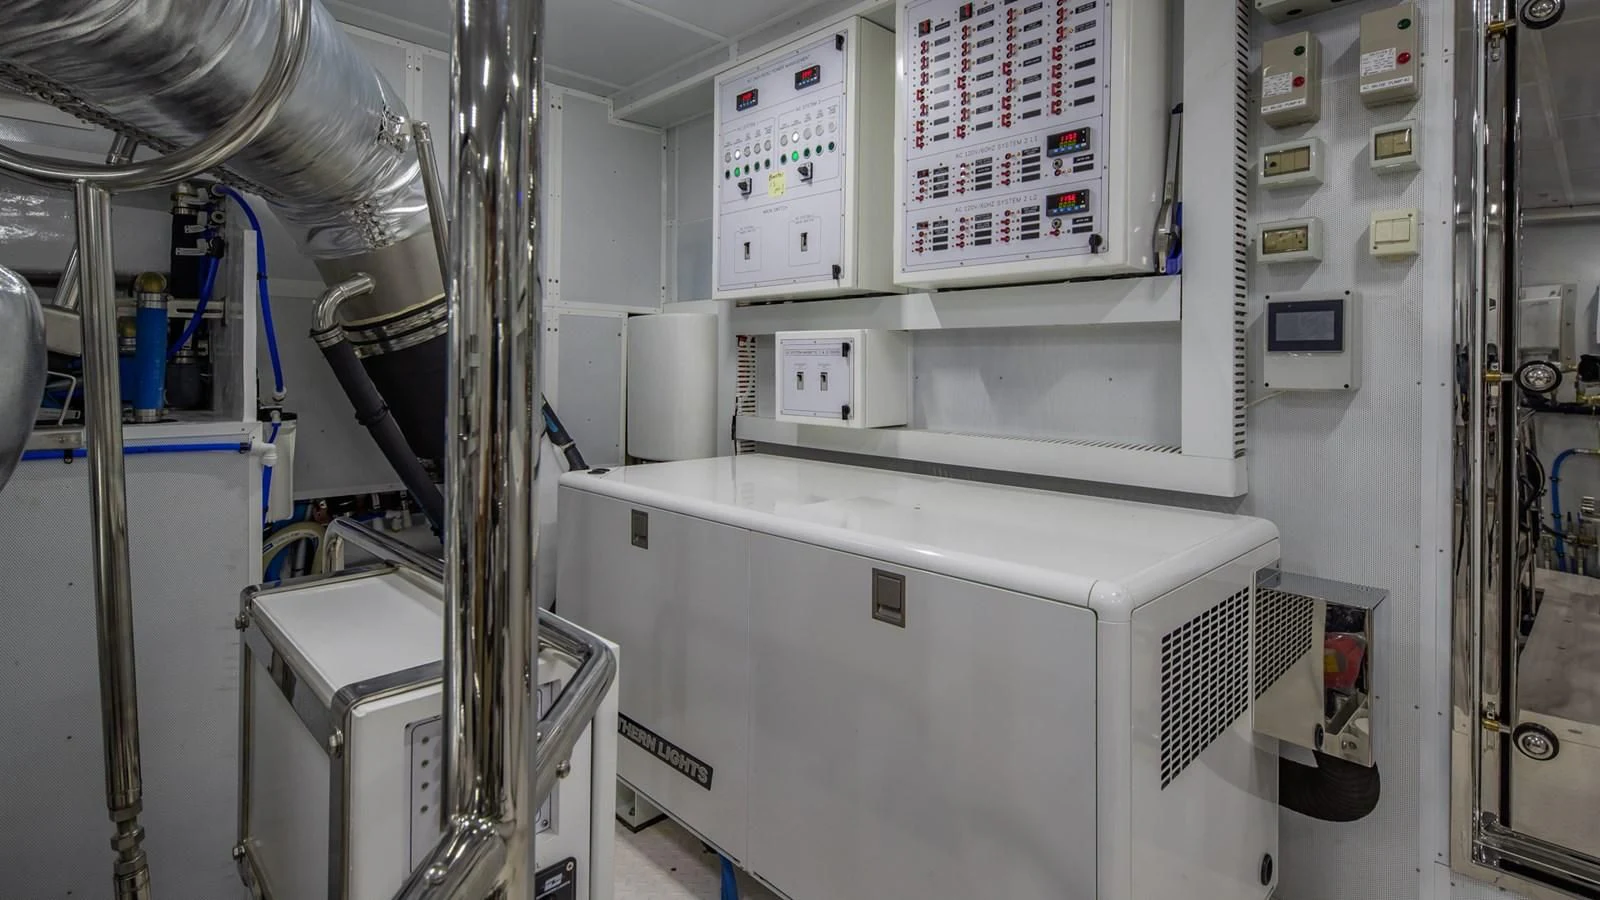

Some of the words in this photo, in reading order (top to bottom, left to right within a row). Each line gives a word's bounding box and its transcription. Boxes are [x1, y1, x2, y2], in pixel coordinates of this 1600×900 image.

[997, 138, 1022, 151] SYSTEM
[996, 196, 1022, 207] SYSTEM
[658, 741, 709, 784] LIGHTS
